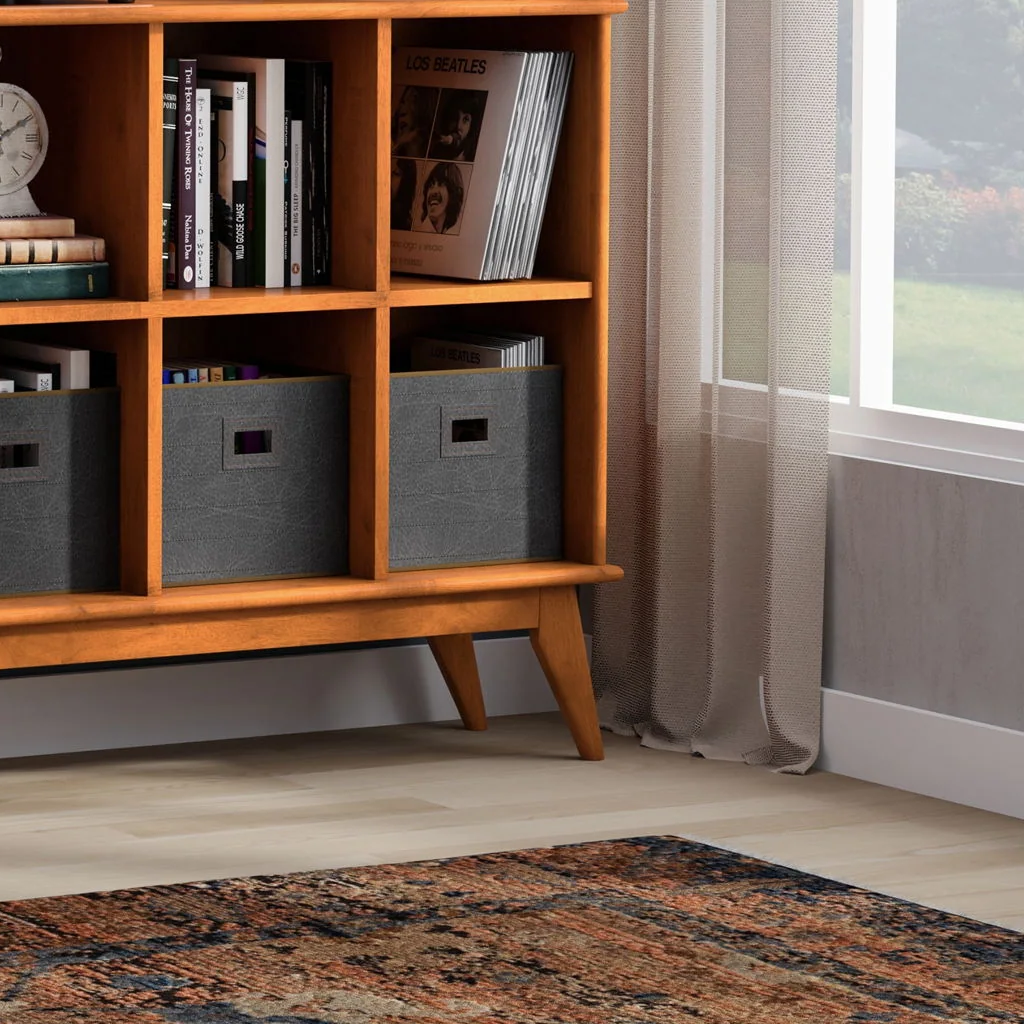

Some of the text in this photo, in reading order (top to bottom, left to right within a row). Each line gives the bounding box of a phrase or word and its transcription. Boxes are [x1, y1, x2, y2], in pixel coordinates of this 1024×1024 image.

[184, 67, 193, 84] THE
[406, 55, 487, 75] LOS BEATLES
[184, 87, 193, 112] HOUSE
[184, 128, 193, 165] TWINING
[184, 166, 193, 190] ROSES
[236, 203, 245, 260] WILD GOOSE CHASE
[447, 349, 481, 365] BEATLES
